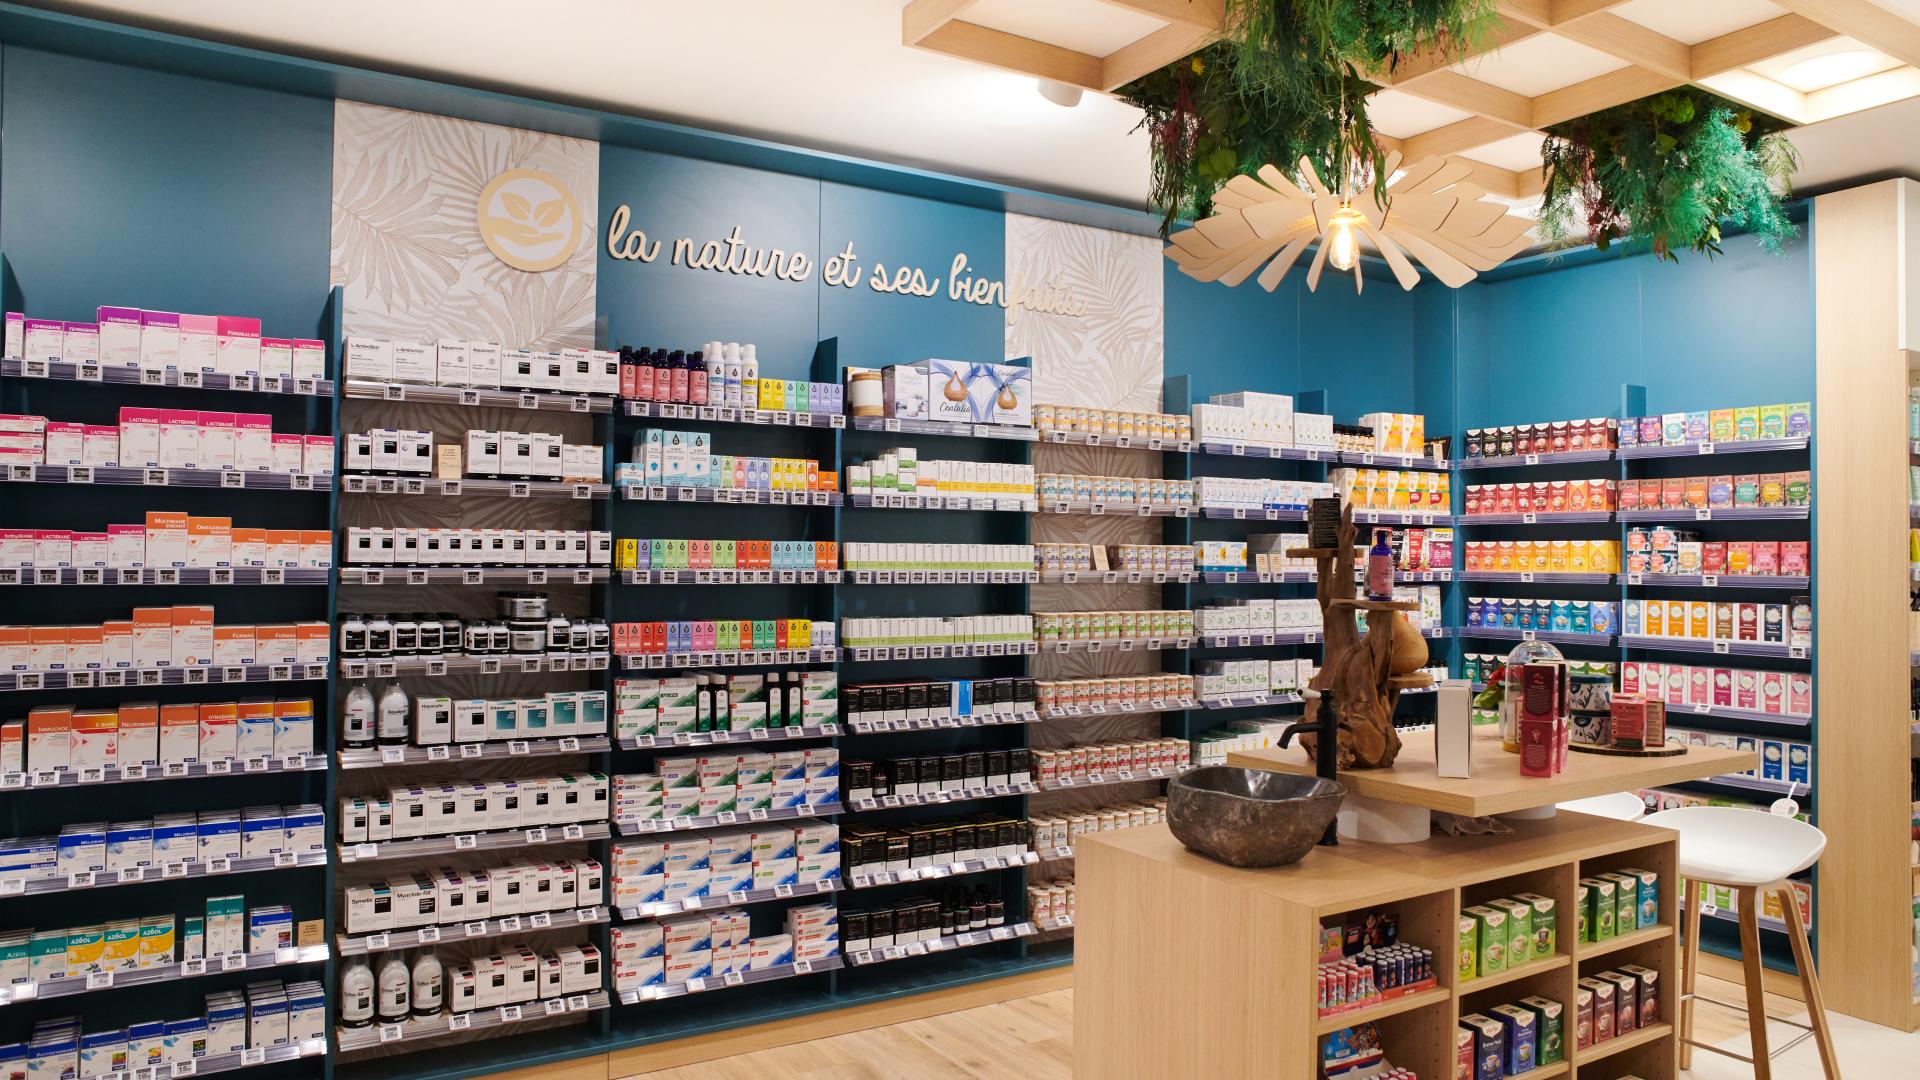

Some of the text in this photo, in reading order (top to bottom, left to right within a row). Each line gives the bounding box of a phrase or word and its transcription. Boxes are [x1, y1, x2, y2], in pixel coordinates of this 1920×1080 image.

[608, 204, 1088, 326] la nature et ses bienfaits
